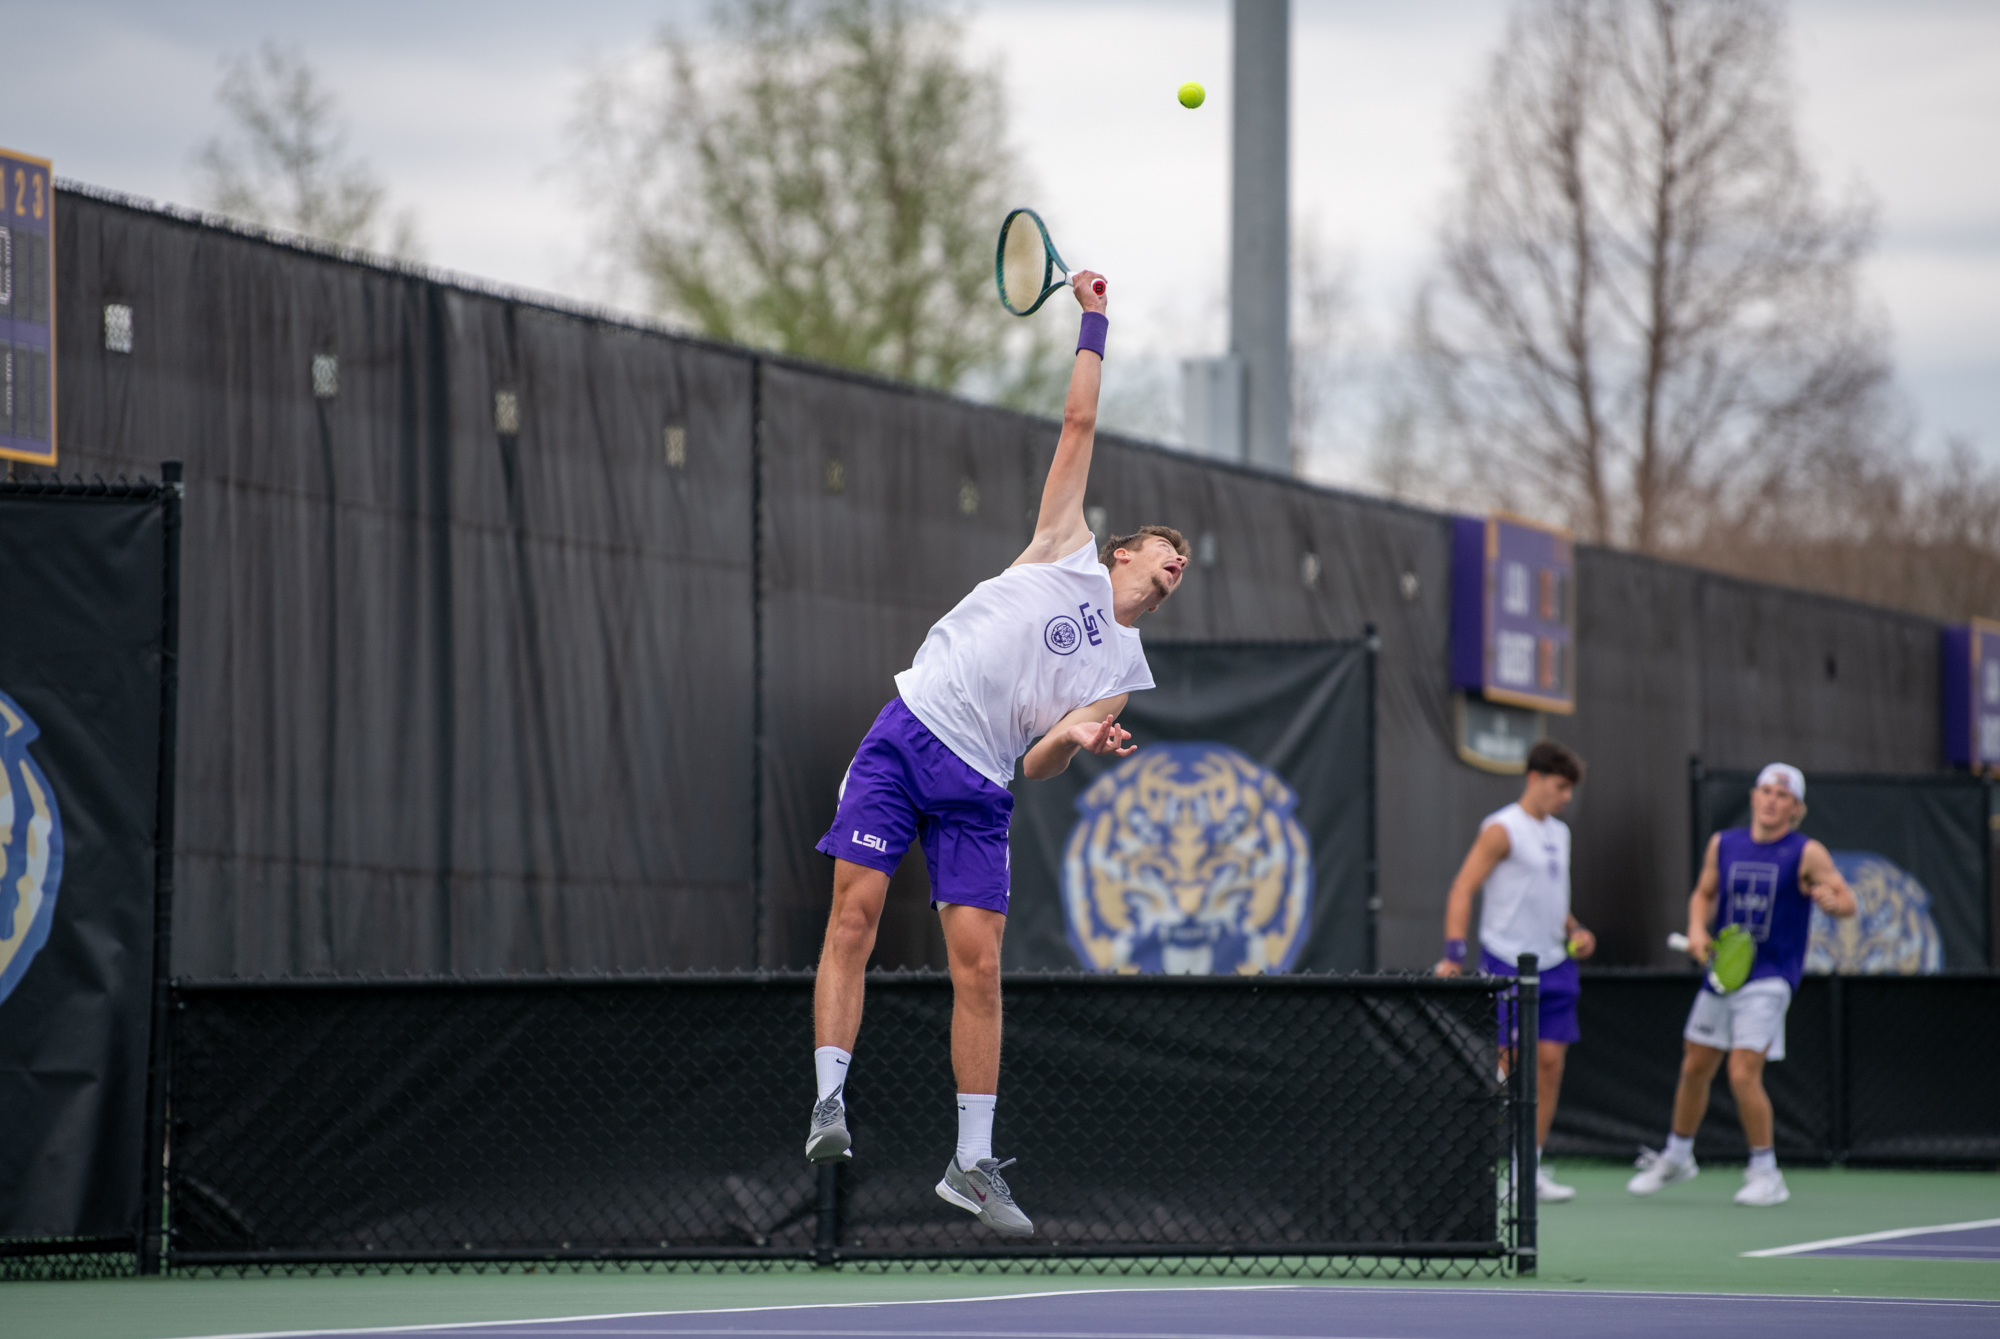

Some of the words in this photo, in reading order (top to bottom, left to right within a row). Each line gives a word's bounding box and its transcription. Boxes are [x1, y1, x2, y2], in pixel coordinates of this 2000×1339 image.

[14, 168, 26, 216] 2
[32, 172, 43, 220] 3
[1079, 602, 1102, 646] LSU
[852, 830, 887, 852] LSU
